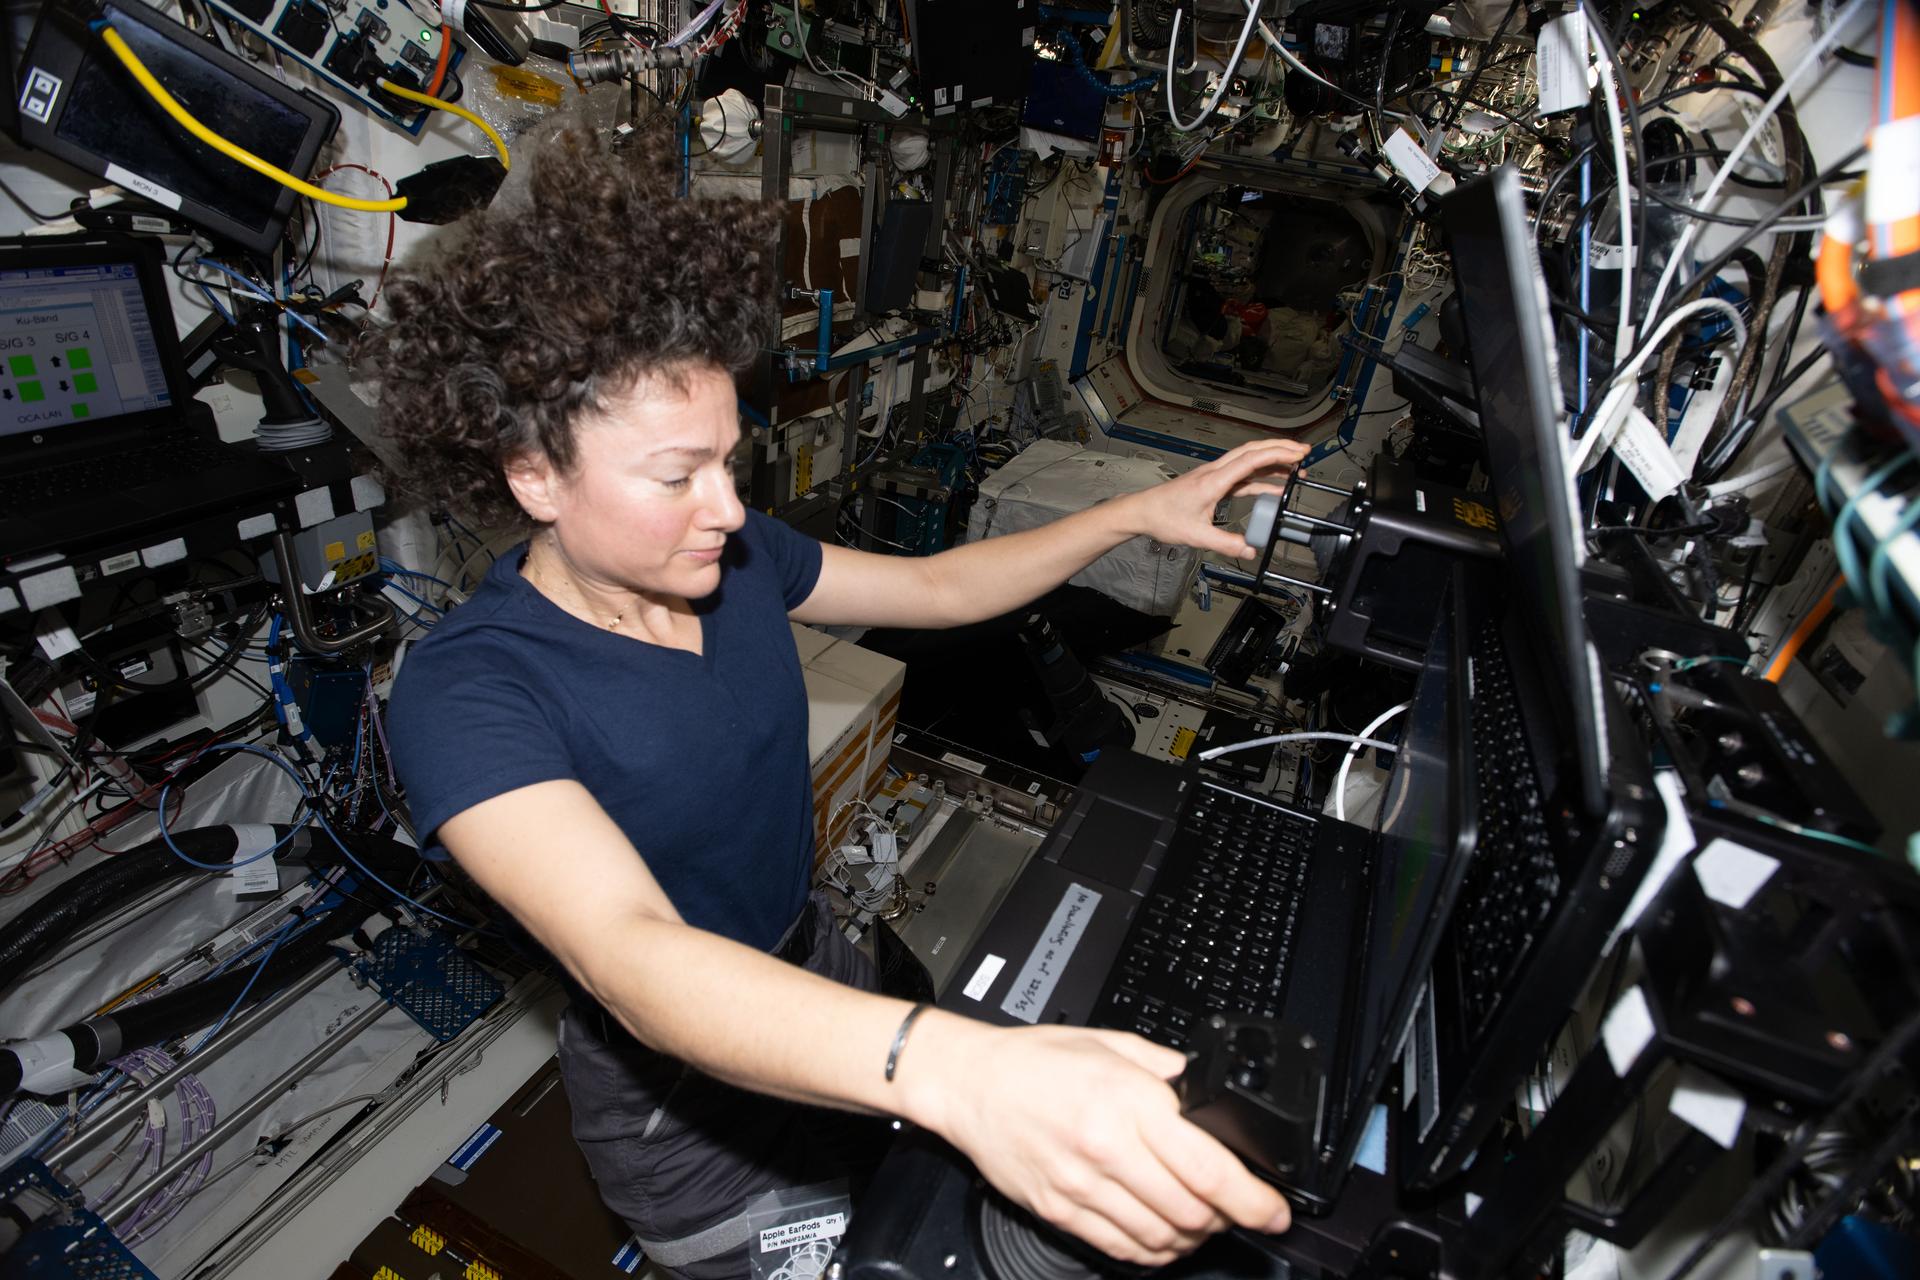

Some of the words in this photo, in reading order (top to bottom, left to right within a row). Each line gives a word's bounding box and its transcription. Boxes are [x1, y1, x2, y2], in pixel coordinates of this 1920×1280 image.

[133, 179, 152, 193] MON
[16, 314, 59, 325] Ku-Band
[26, 336, 36, 346] 3
[55, 331, 79, 343] S/G
[83, 330, 90, 340] 4
[17, 413, 41, 423] OCA
[42, 410, 63, 420] LAN
[762, 1230, 785, 1241] Apple
[788, 1221, 821, 1234] EarPods
[767, 1241, 778, 1249] P/N
